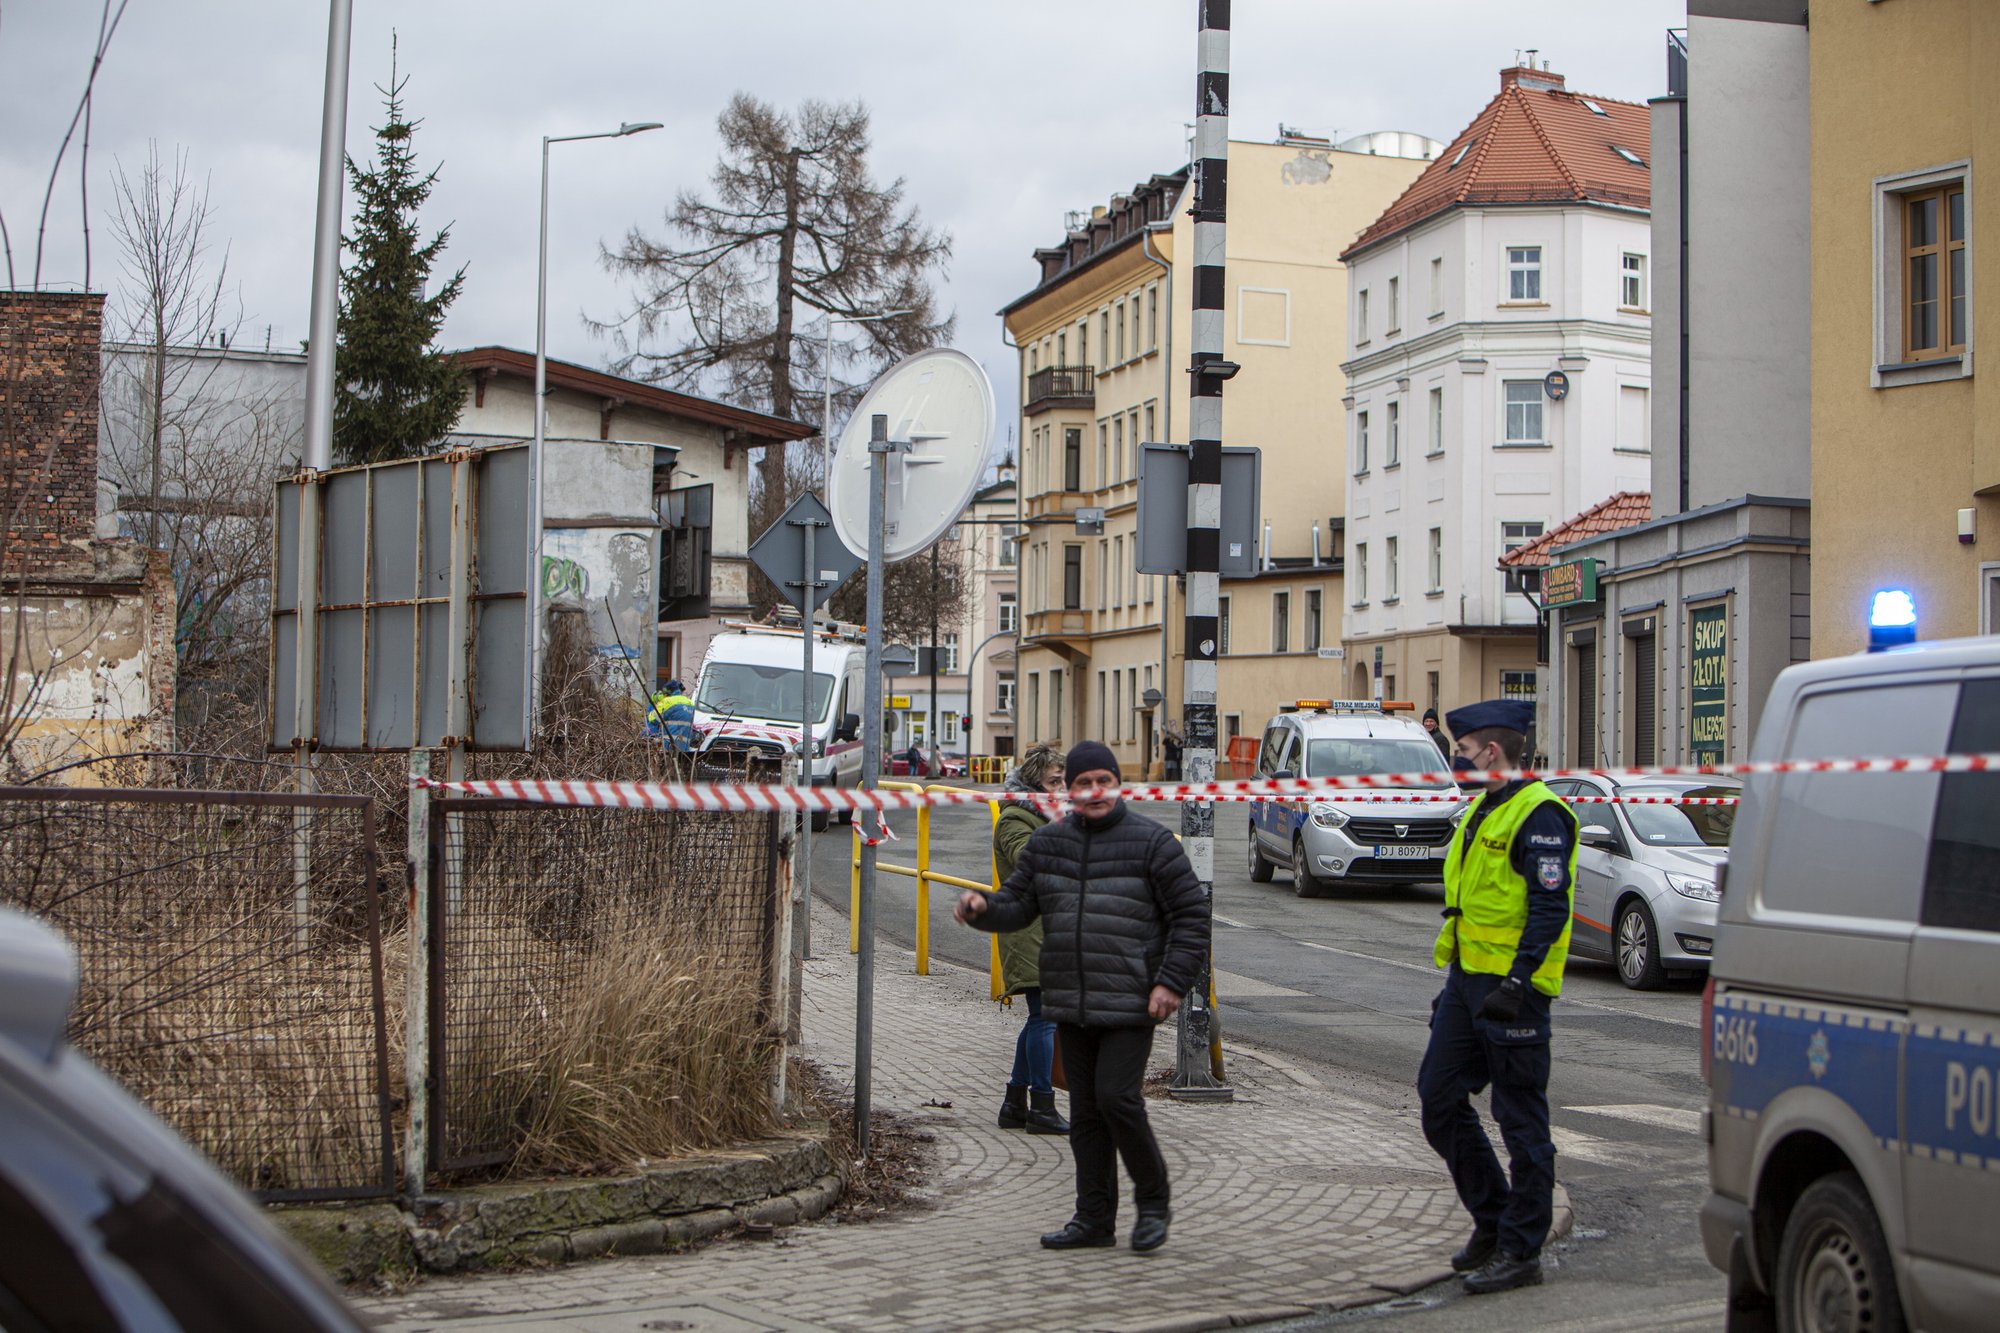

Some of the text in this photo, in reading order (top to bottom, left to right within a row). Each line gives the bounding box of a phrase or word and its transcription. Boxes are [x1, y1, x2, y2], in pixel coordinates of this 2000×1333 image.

[1549, 563, 1575, 587] LOMBARD
[1695, 619, 1726, 651] SKUP
[1693, 655, 1726, 687] ZŁOTA
[1354, 701, 1379, 709] MIEJSKA
[1531, 835, 1562, 845] POLICJA
[1381, 847, 1428, 856] DJ 80977
[1506, 1029, 1537, 1038] POLICJA
[1715, 1014, 1758, 1066] B616
